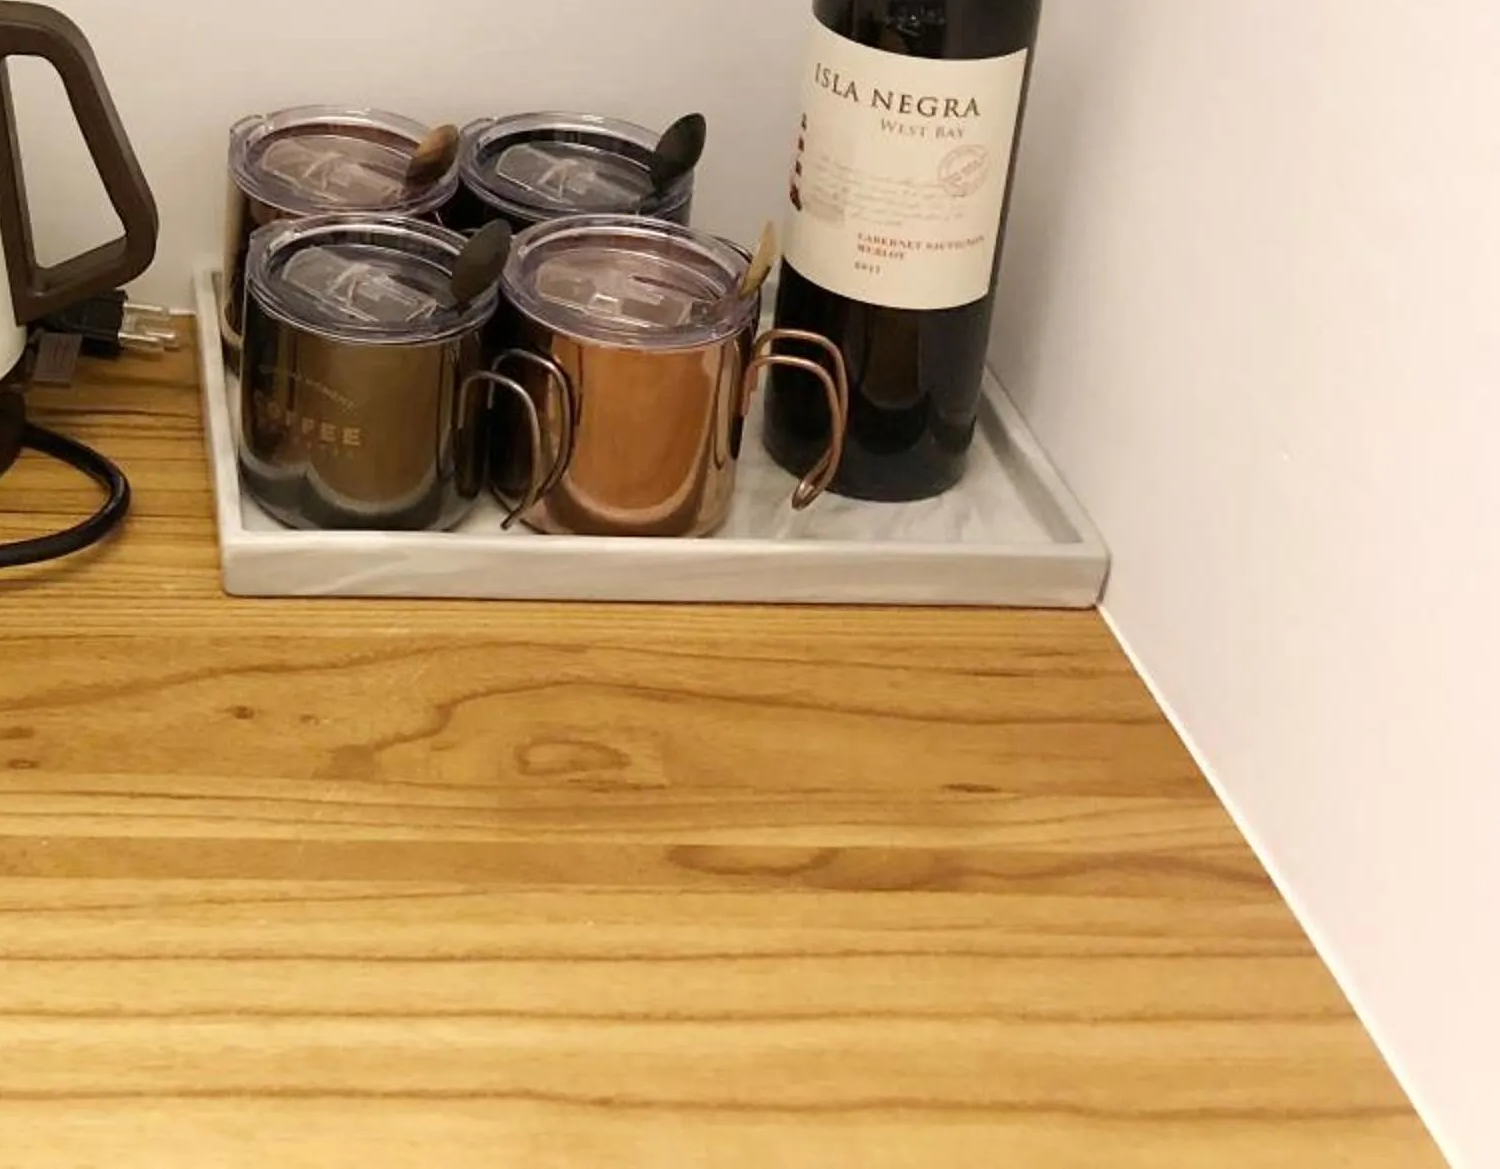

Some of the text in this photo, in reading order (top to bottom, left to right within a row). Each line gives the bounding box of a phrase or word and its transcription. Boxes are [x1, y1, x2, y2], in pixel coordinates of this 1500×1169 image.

[814, 62, 981, 119] ISLA NEGRA
[881, 118, 964, 139] WEST BAY
